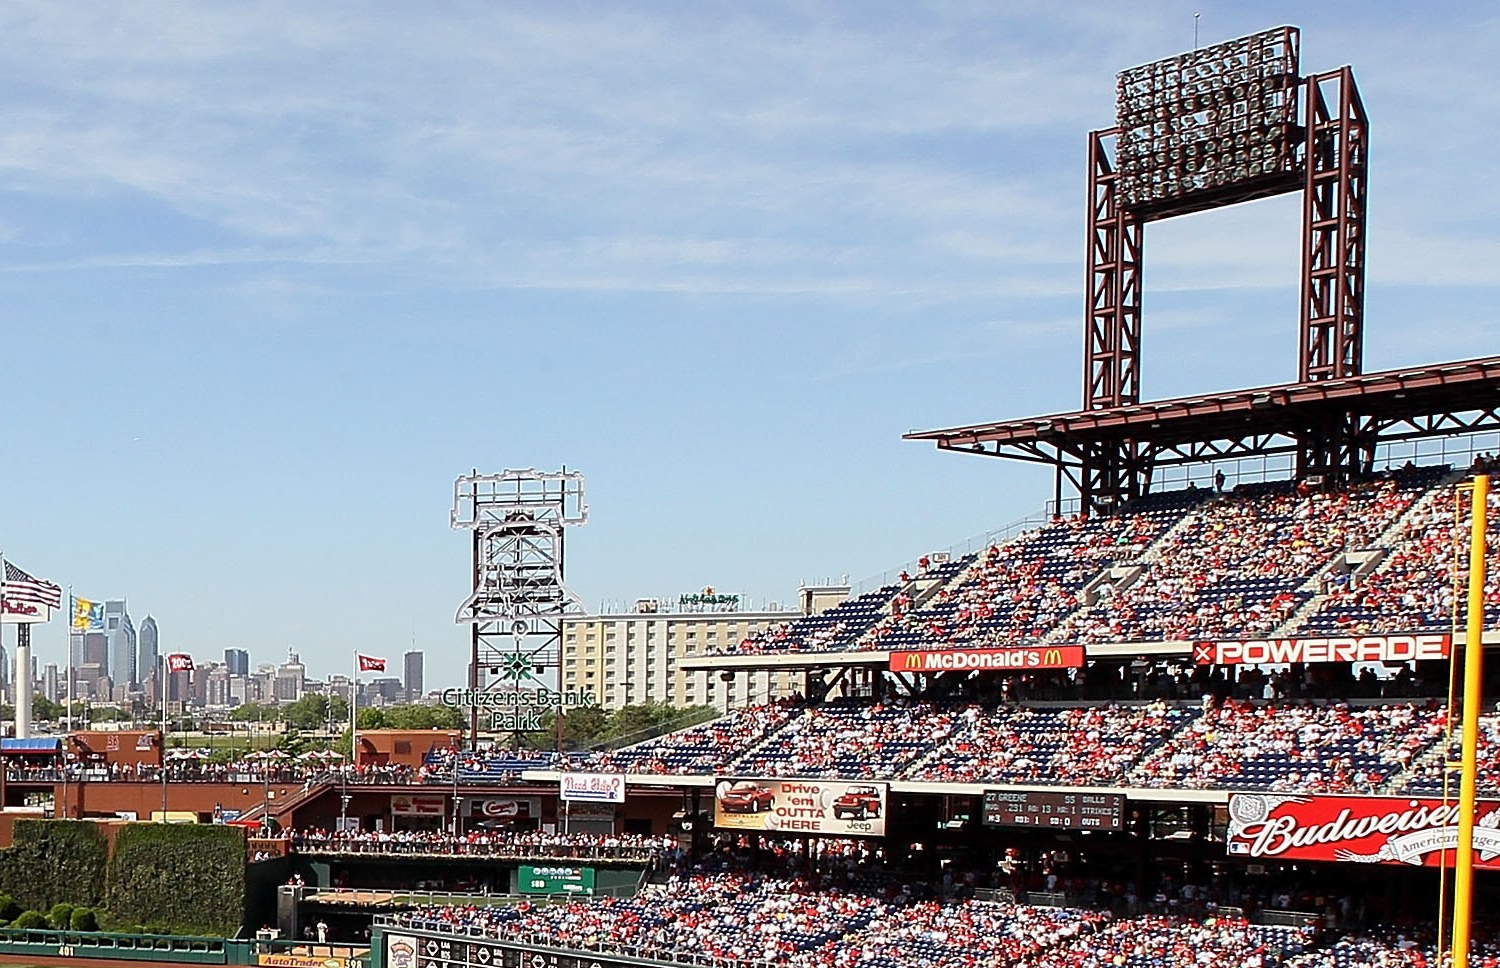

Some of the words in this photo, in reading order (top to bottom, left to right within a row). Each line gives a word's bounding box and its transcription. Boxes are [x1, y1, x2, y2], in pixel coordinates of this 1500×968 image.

[924, 650, 1041, 668] McDonald's
[443, 688, 530, 707] Citizens
[537, 688, 594, 706] Bank
[492, 712, 542, 730] Park
[565, 778, 587, 791] Need
[782, 784, 820, 794] Drive
[998, 794, 1027, 802] GREENE
[776, 808, 826, 818] OUTTA
[1005, 804, 1022, 812] .231
[780, 820, 820, 830] HERE
[846, 820, 872, 831] Jeep
[1474, 836, 1500, 847] ager
[59, 946, 73, 956] 401
[264, 957, 323, 968] AutoTrader
